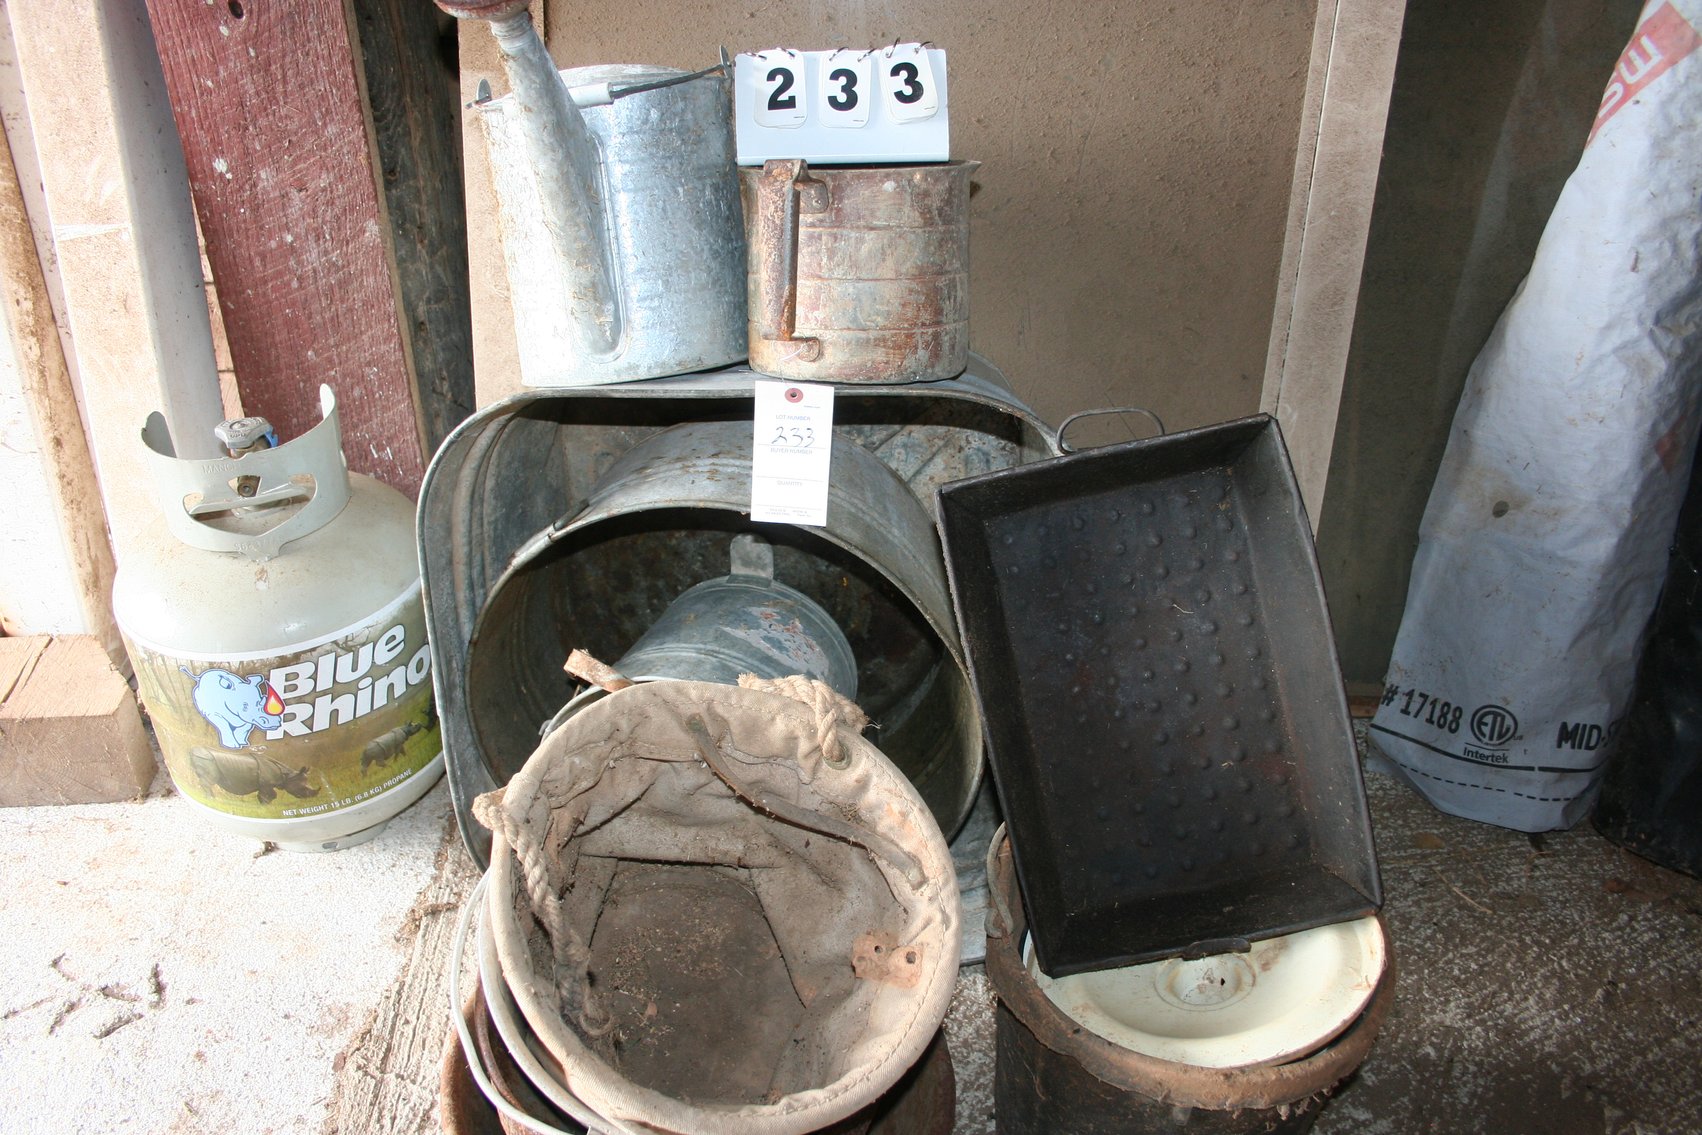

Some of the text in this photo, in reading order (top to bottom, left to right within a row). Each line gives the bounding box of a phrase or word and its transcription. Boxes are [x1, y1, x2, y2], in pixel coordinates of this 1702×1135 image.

[771, 426, 815, 448] 233
[268, 624, 405, 699] Blue
[266, 644, 432, 740] Rhino
[1400, 688, 1463, 734] 17188
[1463, 746, 1509, 764] Intertek
[282, 809, 298, 817] NET
[299, 804, 329, 815] WEIGHT
[330, 801, 340, 809] 15
[341, 797, 354, 806] LB.
[369, 785, 382, 795] KG)
[383, 768, 413, 789] PROPANE
